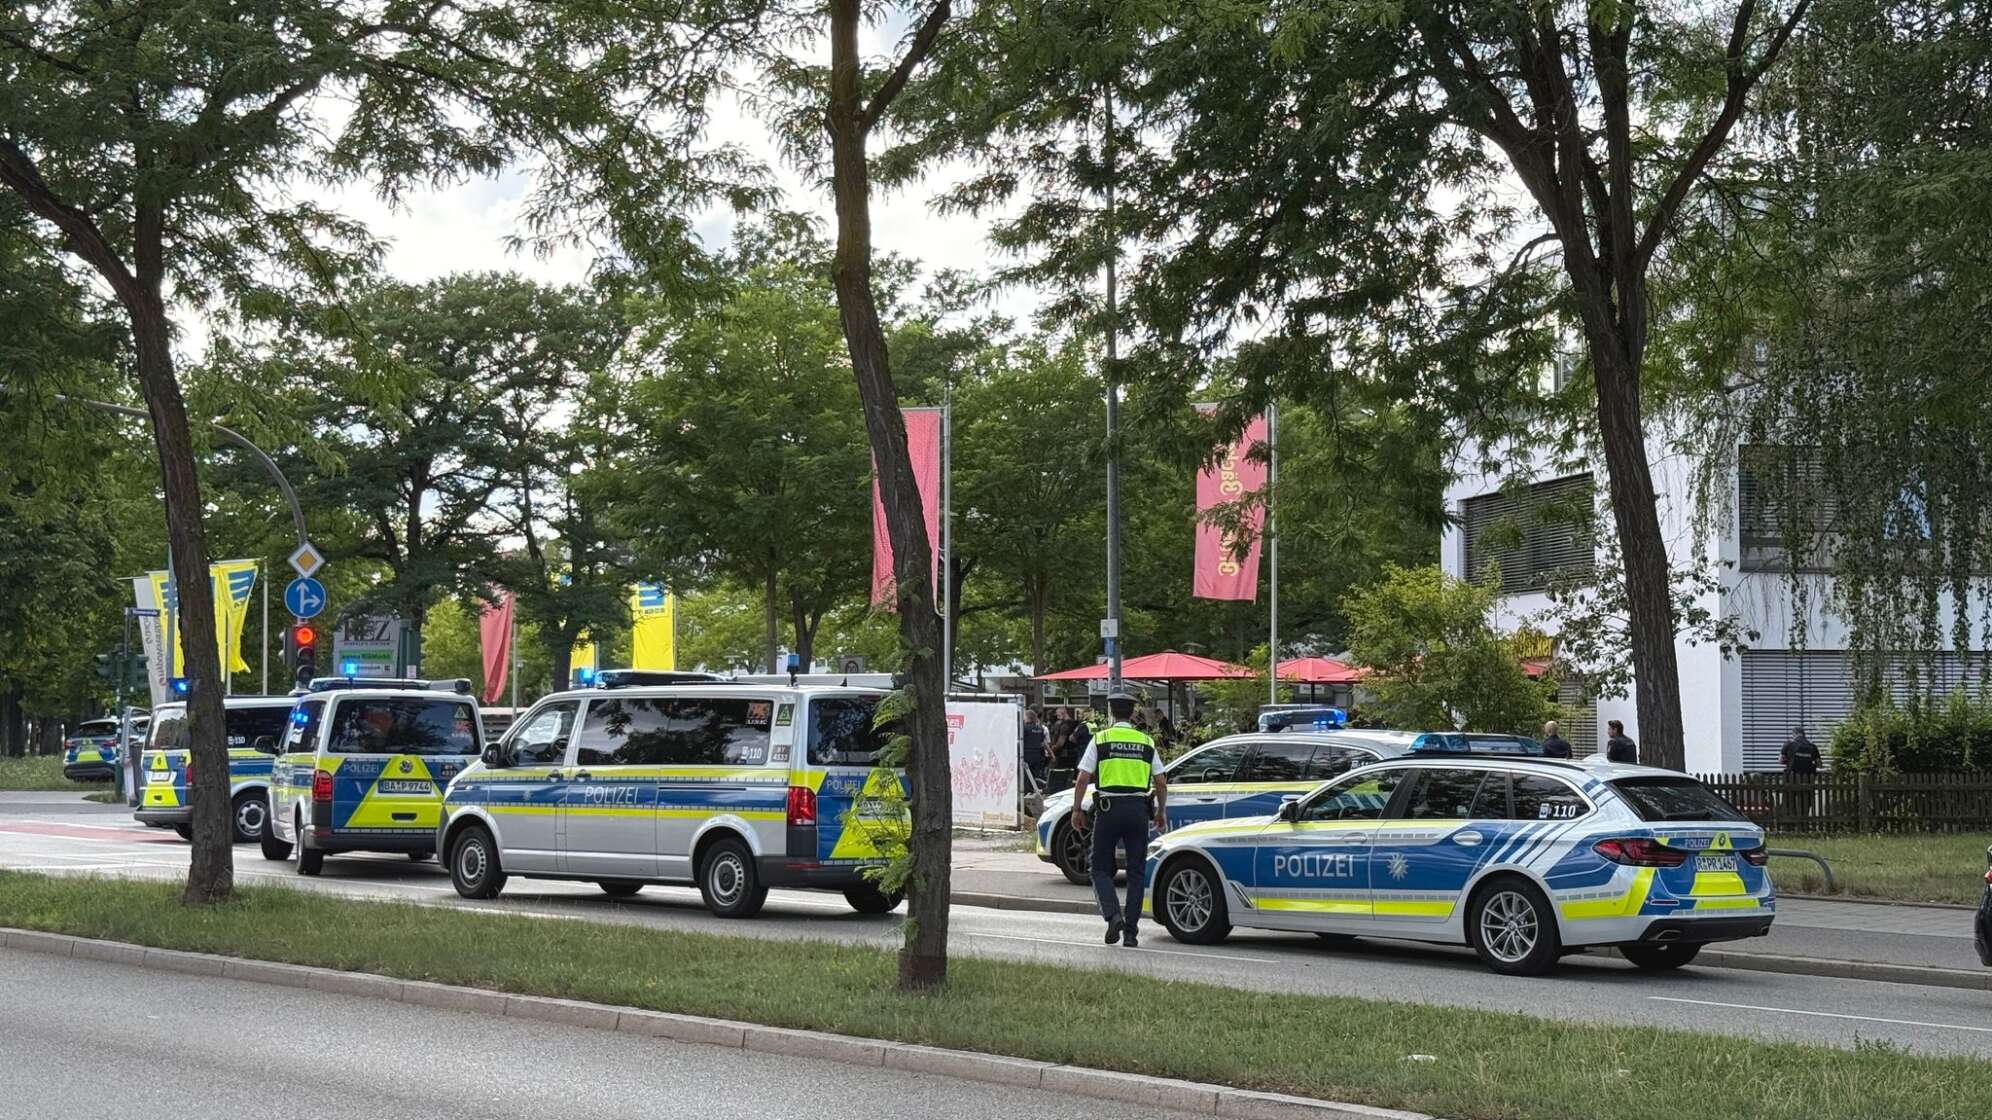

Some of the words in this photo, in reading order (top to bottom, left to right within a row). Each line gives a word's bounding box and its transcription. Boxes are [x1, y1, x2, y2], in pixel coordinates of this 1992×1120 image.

[749, 747, 762, 759] 110
[1110, 743, 1145, 752] POLIZEI
[343, 763, 380, 773] POLIZEI
[584, 786, 639, 804] POLIZEI
[1552, 805, 1576, 817] 110
[1684, 838, 1710, 848] POLIZEI
[1274, 854, 1354, 877] POLIZEI
